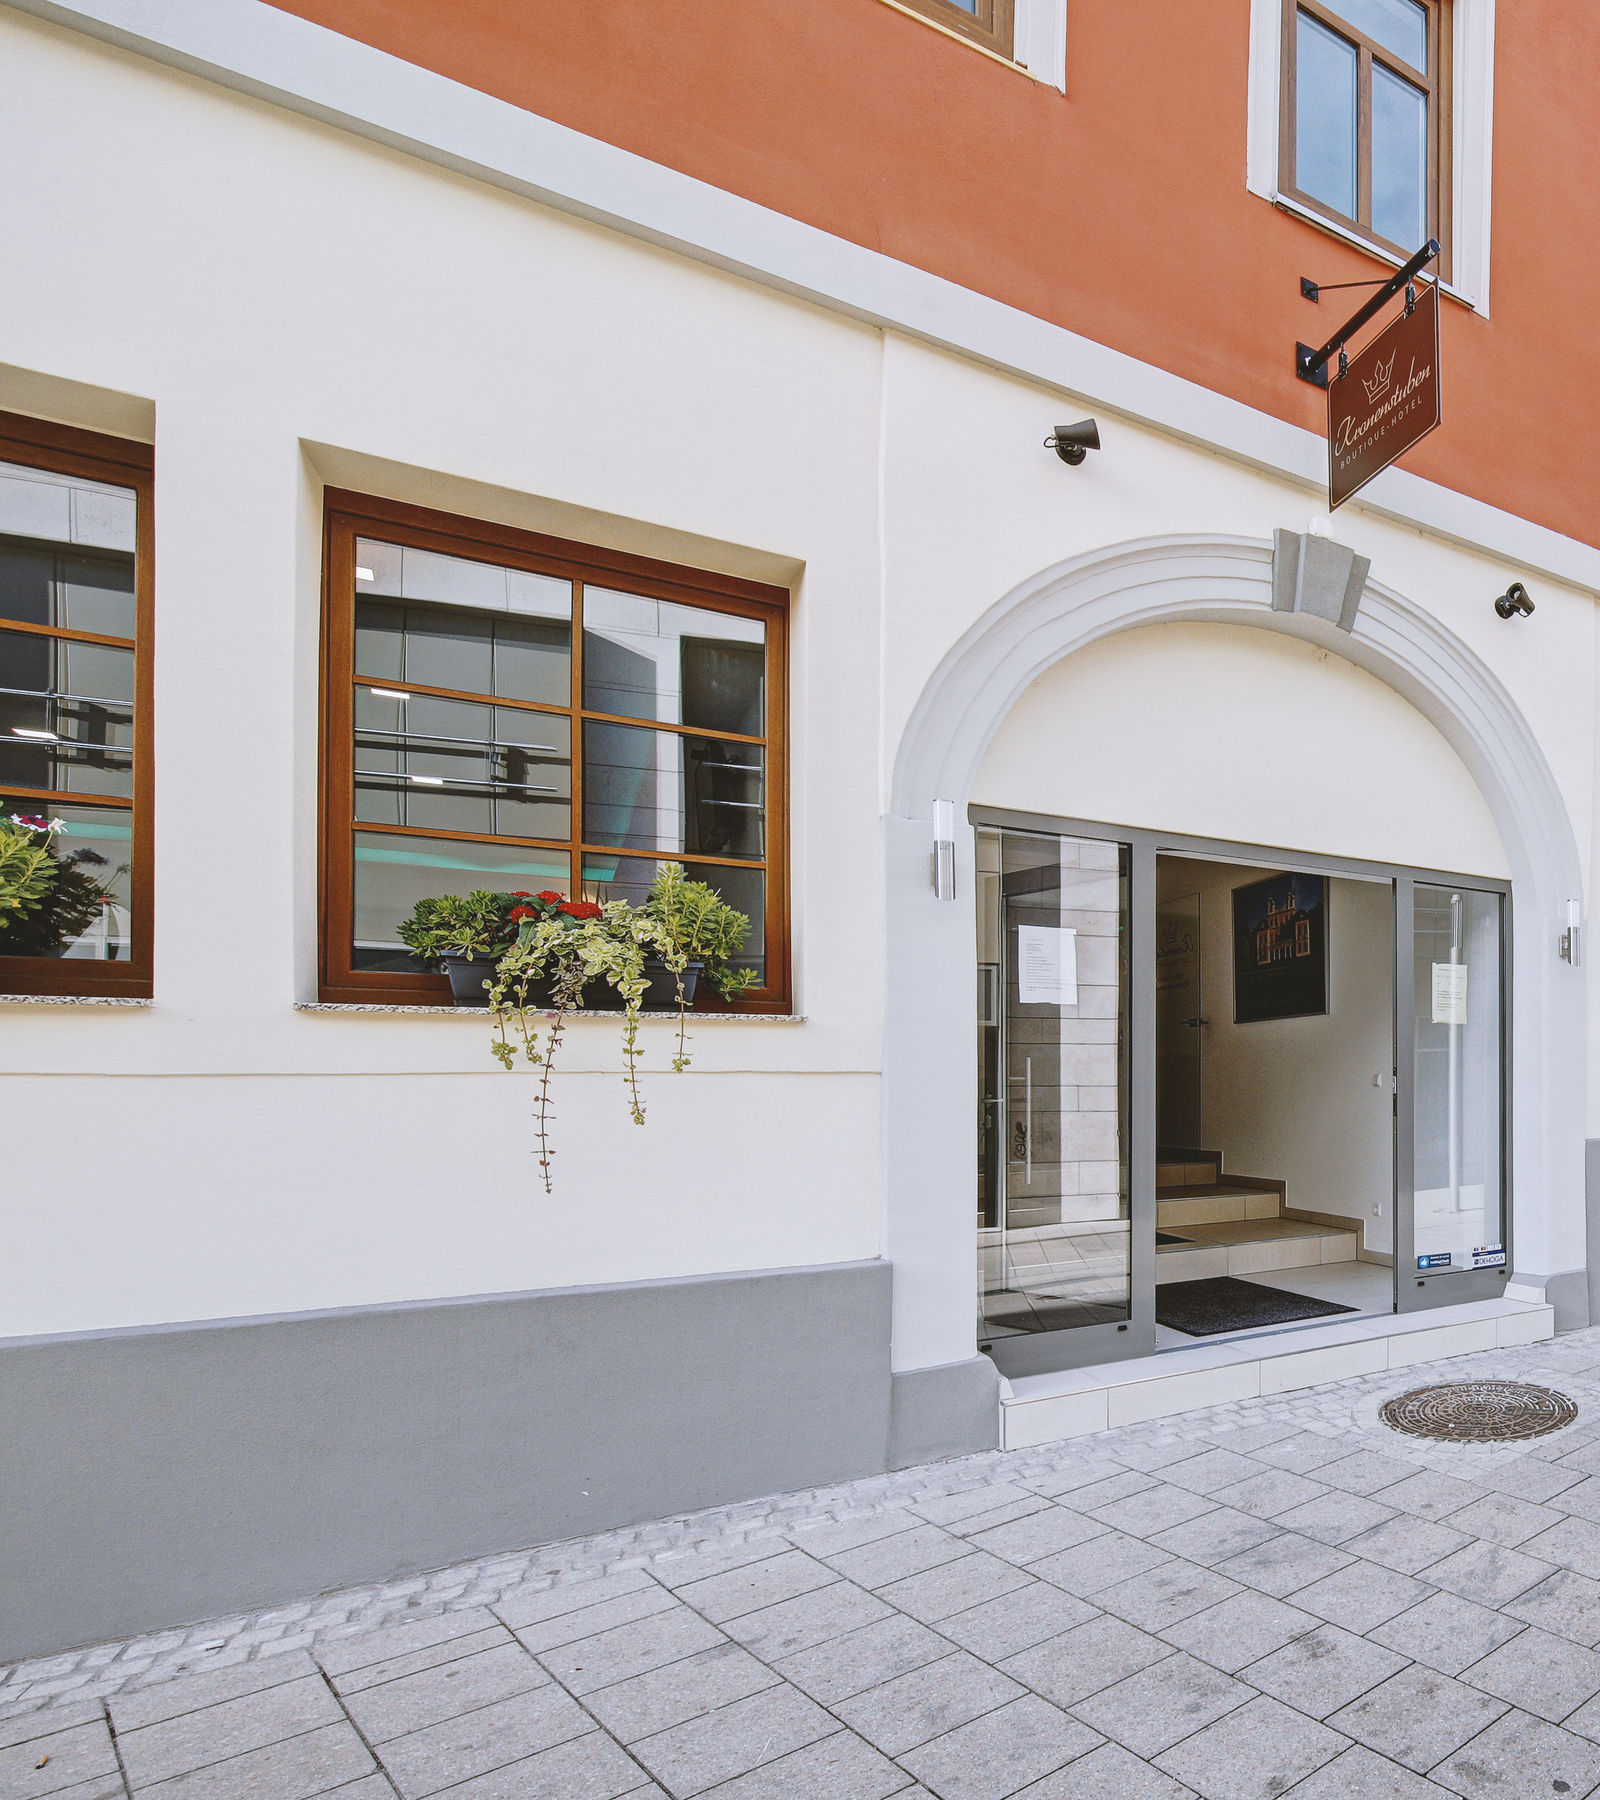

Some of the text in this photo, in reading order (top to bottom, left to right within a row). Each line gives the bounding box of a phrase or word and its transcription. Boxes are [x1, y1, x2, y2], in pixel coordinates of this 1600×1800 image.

[1334, 355, 1432, 457] Kronenstuben
[1340, 397, 1423, 470] BOUTIQUE-HOTEL
[1479, 1255, 1504, 1265] DEHOGA
